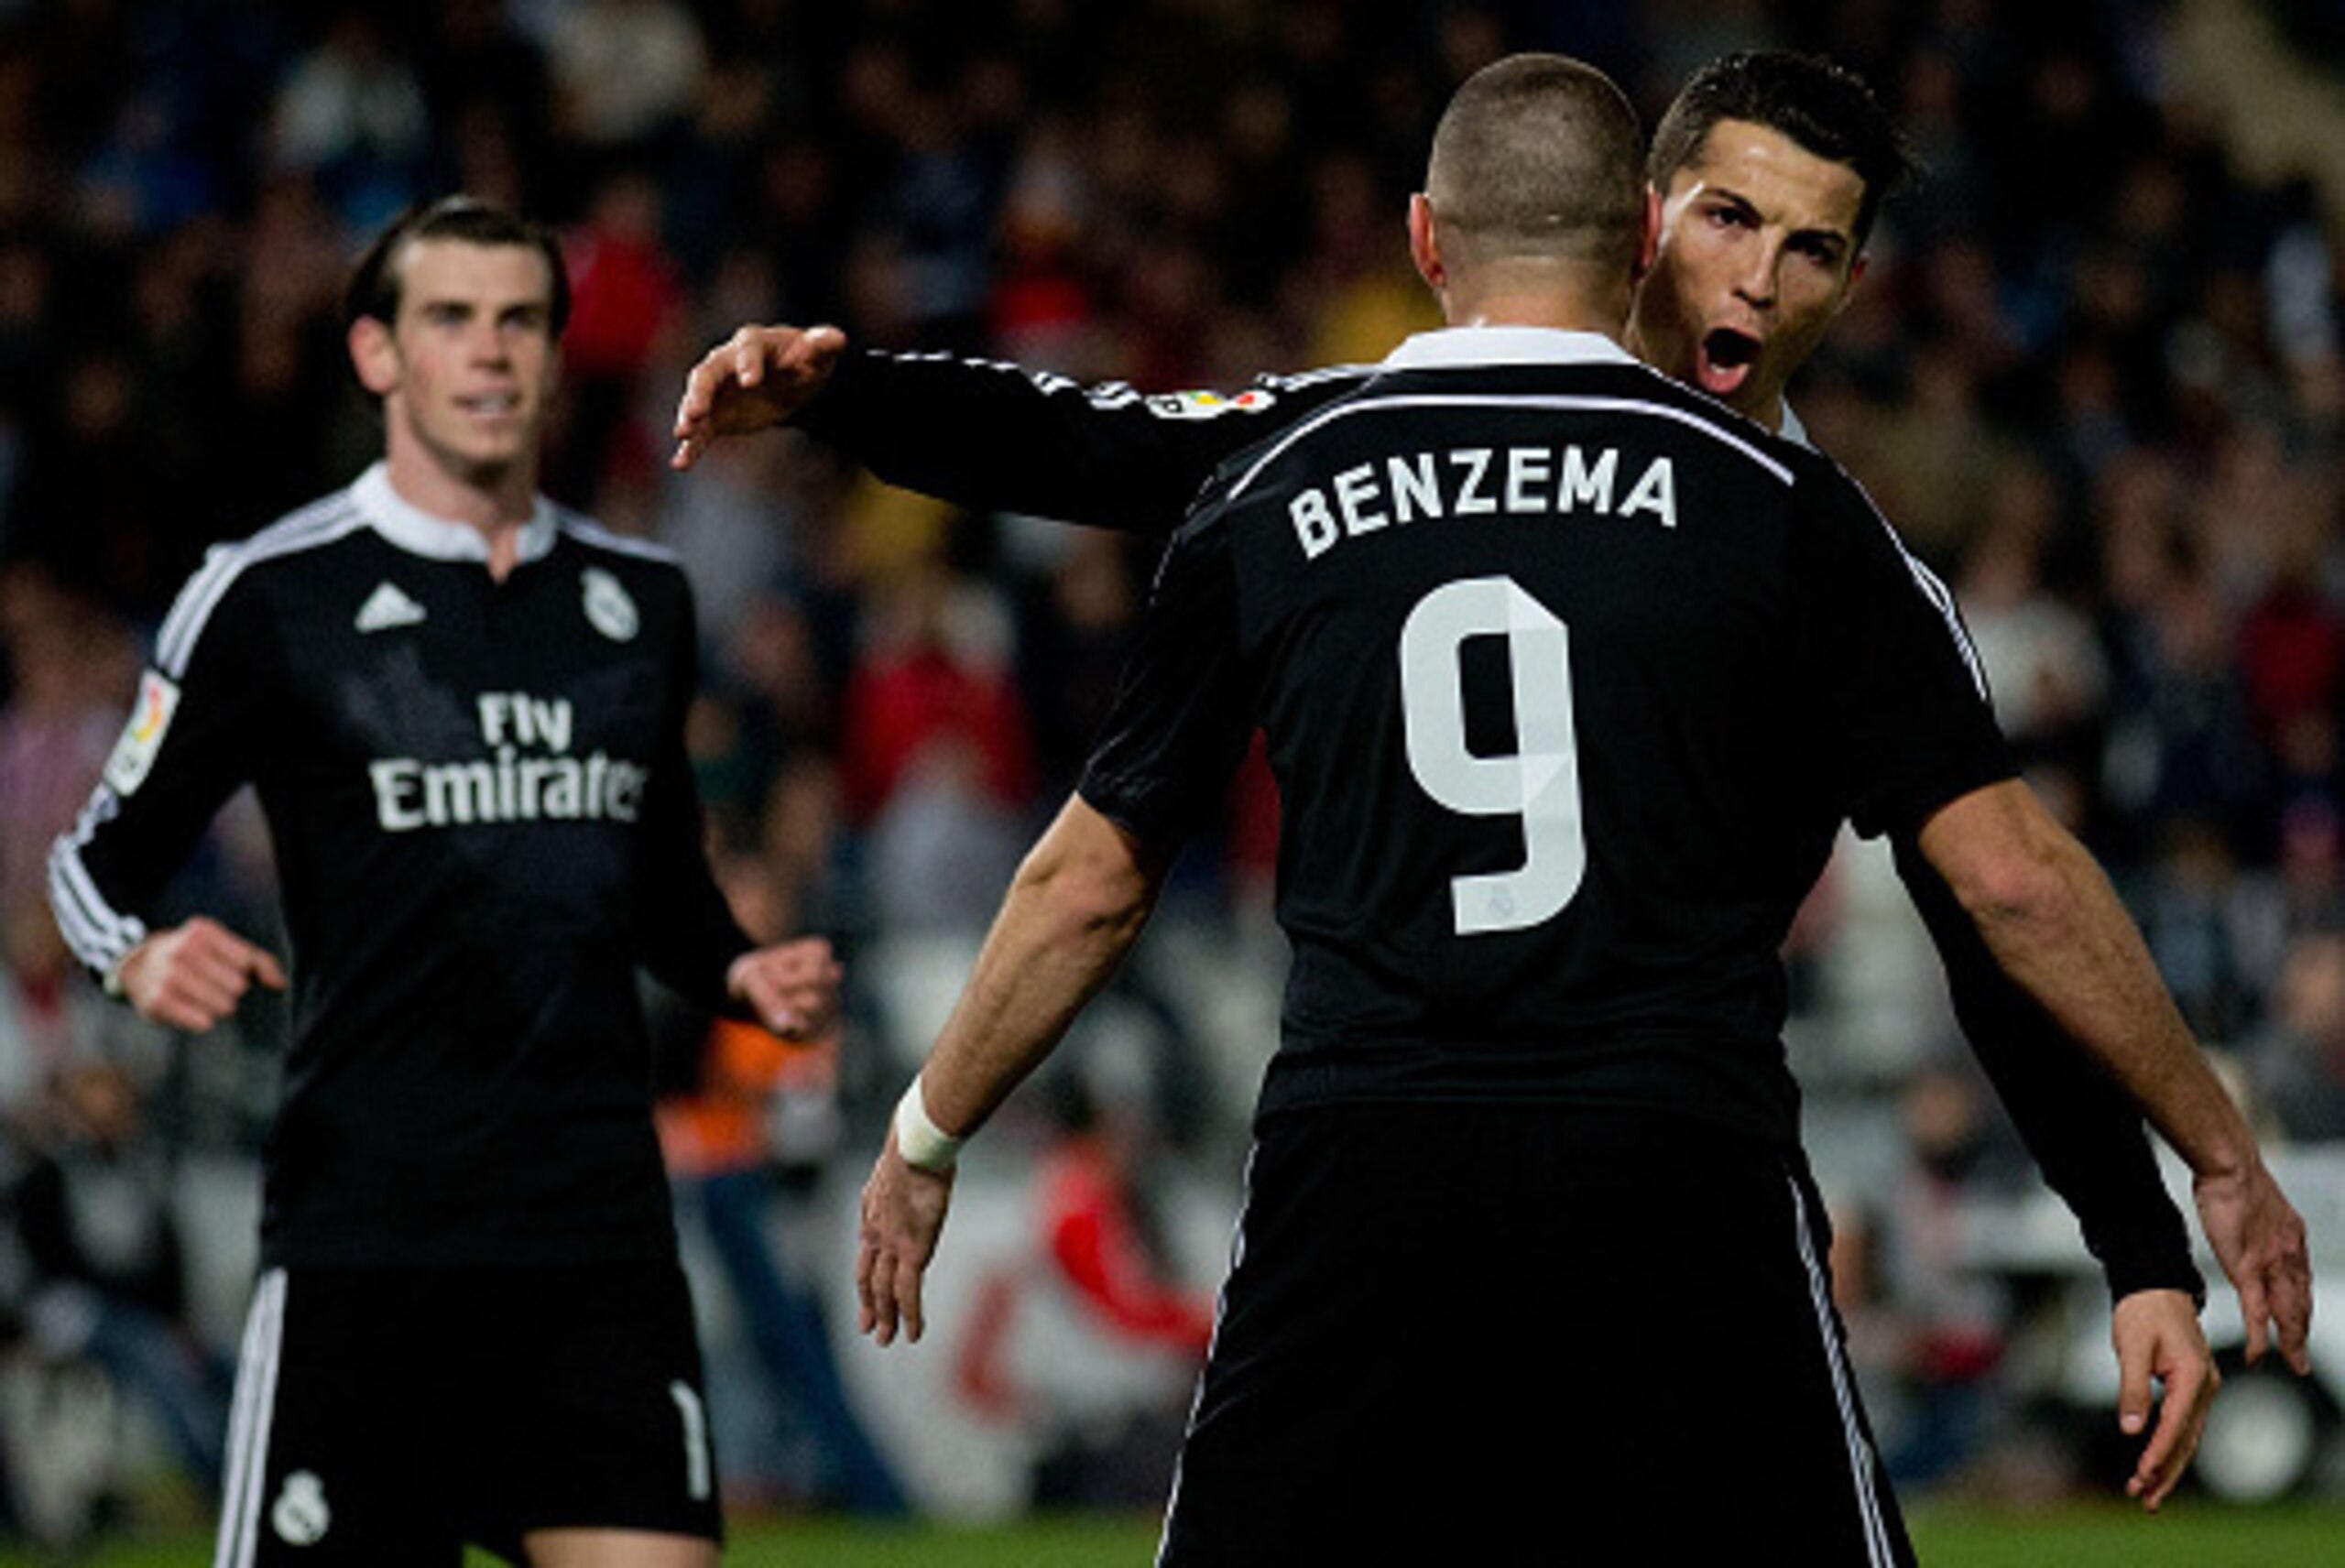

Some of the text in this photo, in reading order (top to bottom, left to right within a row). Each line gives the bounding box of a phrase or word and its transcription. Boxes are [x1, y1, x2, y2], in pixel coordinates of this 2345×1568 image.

[1288, 444, 1677, 561] BENZEMA
[477, 691, 573, 754] Fly
[1400, 575, 1586, 934] 9
[368, 743, 650, 831] Emirate
